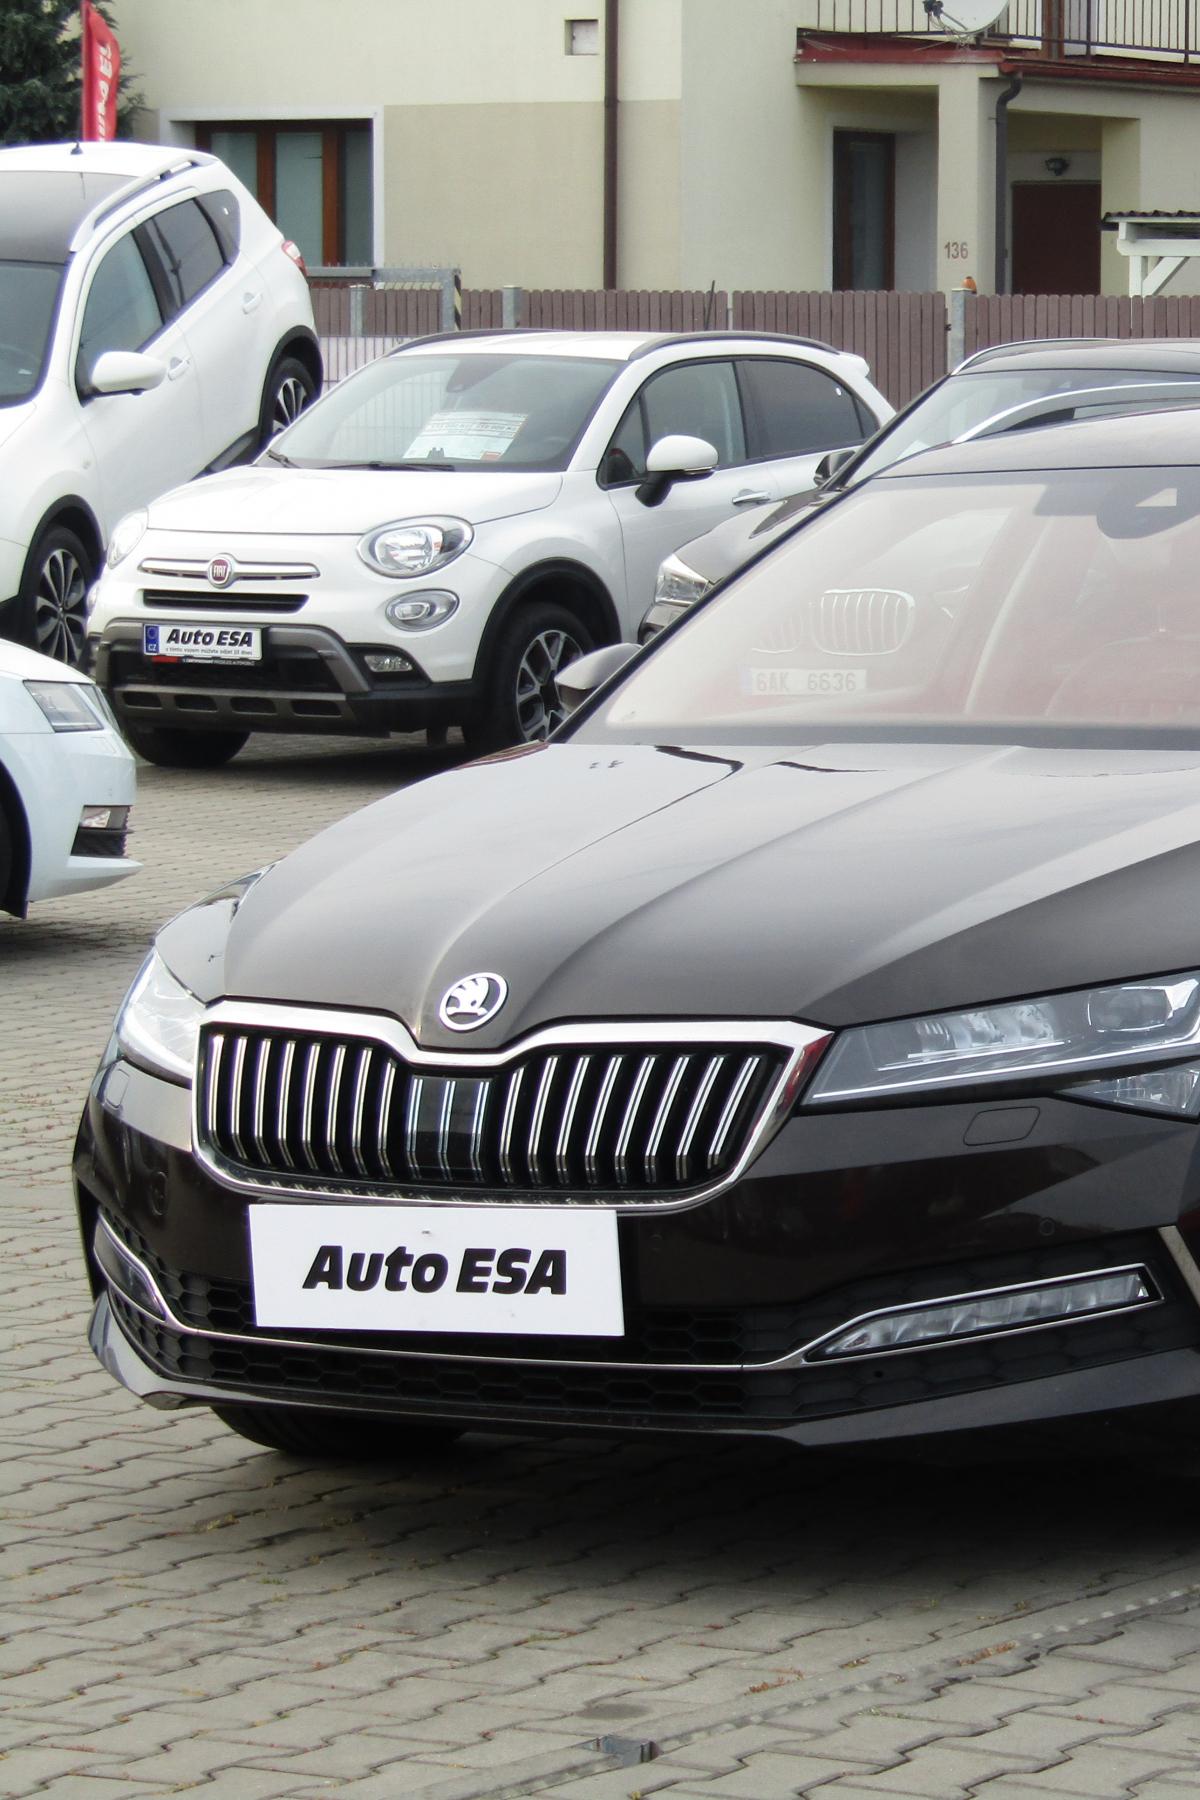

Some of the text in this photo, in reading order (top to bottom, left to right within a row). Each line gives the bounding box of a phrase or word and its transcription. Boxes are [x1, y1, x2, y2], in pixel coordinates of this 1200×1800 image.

[944, 241, 969, 259] 136
[213, 565, 227, 578] FIAT
[166, 628, 253, 647] Auto ESA
[148, 643, 157, 652] CZ
[302, 1245, 567, 1295] Auto ESA
